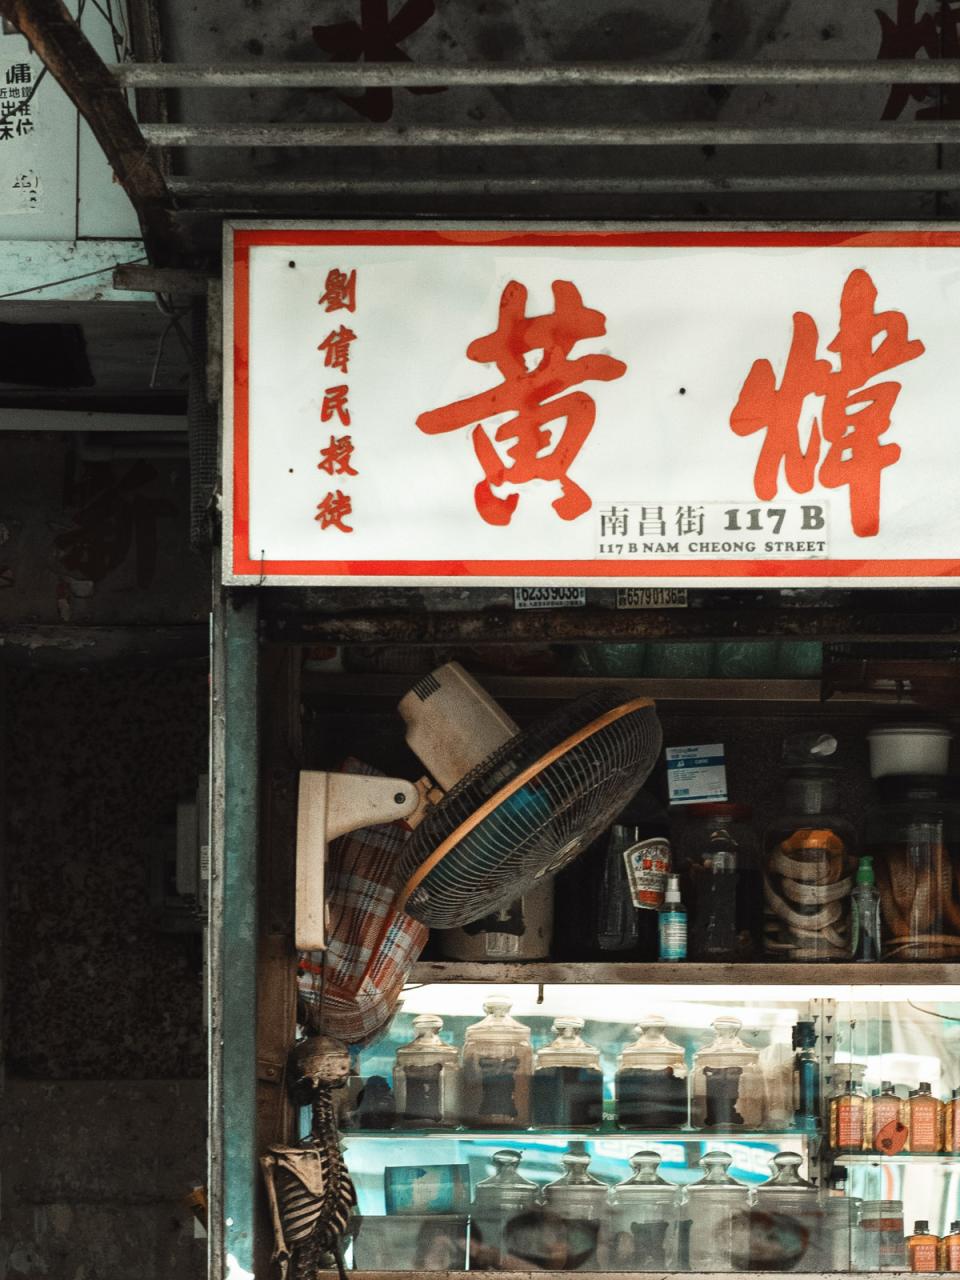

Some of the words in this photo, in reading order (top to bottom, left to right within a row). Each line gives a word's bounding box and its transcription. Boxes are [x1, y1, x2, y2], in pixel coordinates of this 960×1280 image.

[315, 267, 359, 532] 劉偉民授徒
[599, 504, 705, 538] 南昌街
[723, 508, 785, 533] 117
[800, 505, 826, 533] B
[642, 541, 680, 554] NAM
[688, 541, 757, 554] CHEONG
[764, 541, 826, 554] STREET
